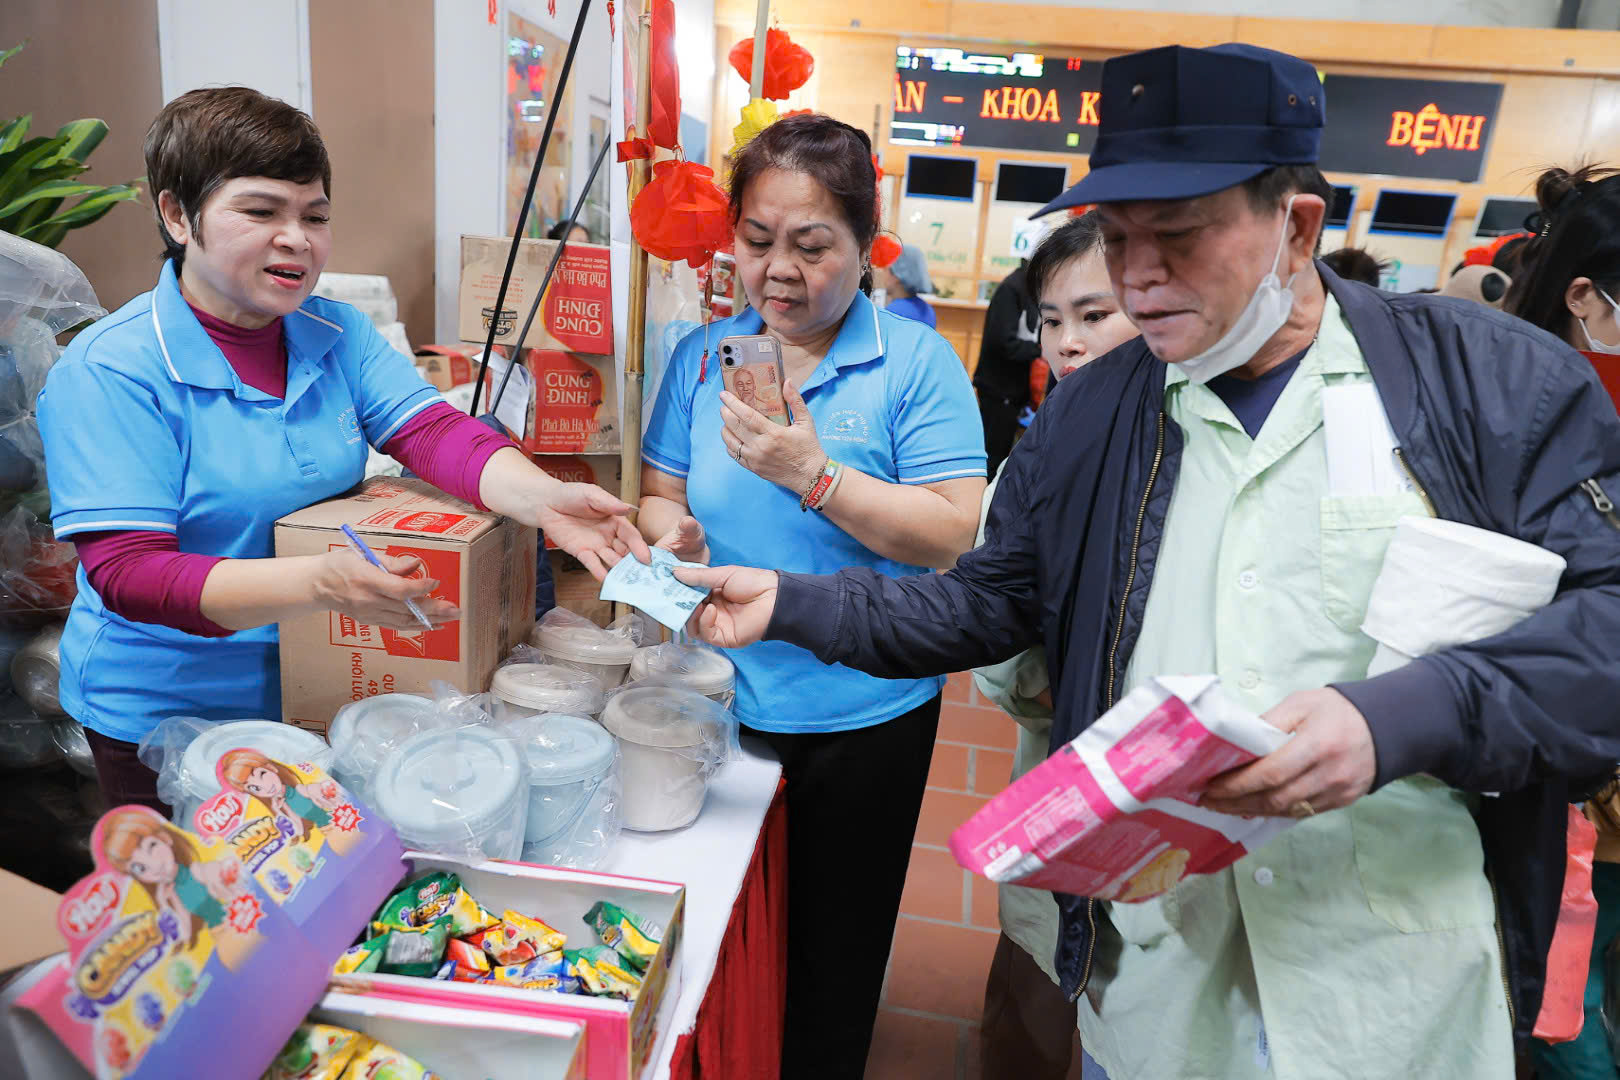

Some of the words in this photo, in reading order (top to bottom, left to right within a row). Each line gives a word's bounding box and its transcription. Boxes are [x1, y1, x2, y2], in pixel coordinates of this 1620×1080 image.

[980, 86, 1061, 122] KHOA
[1386, 103, 1487, 156] BỆNH
[928, 222, 945, 246] 7
[1015, 231, 1028, 251] 6
[558, 300, 601, 319] ĐÌNH
[555, 316, 602, 336] CUNG
[545, 372, 591, 388] CUNG
[546, 387, 588, 404] ĐÌNH
[351, 652, 366, 678] KHỐI
